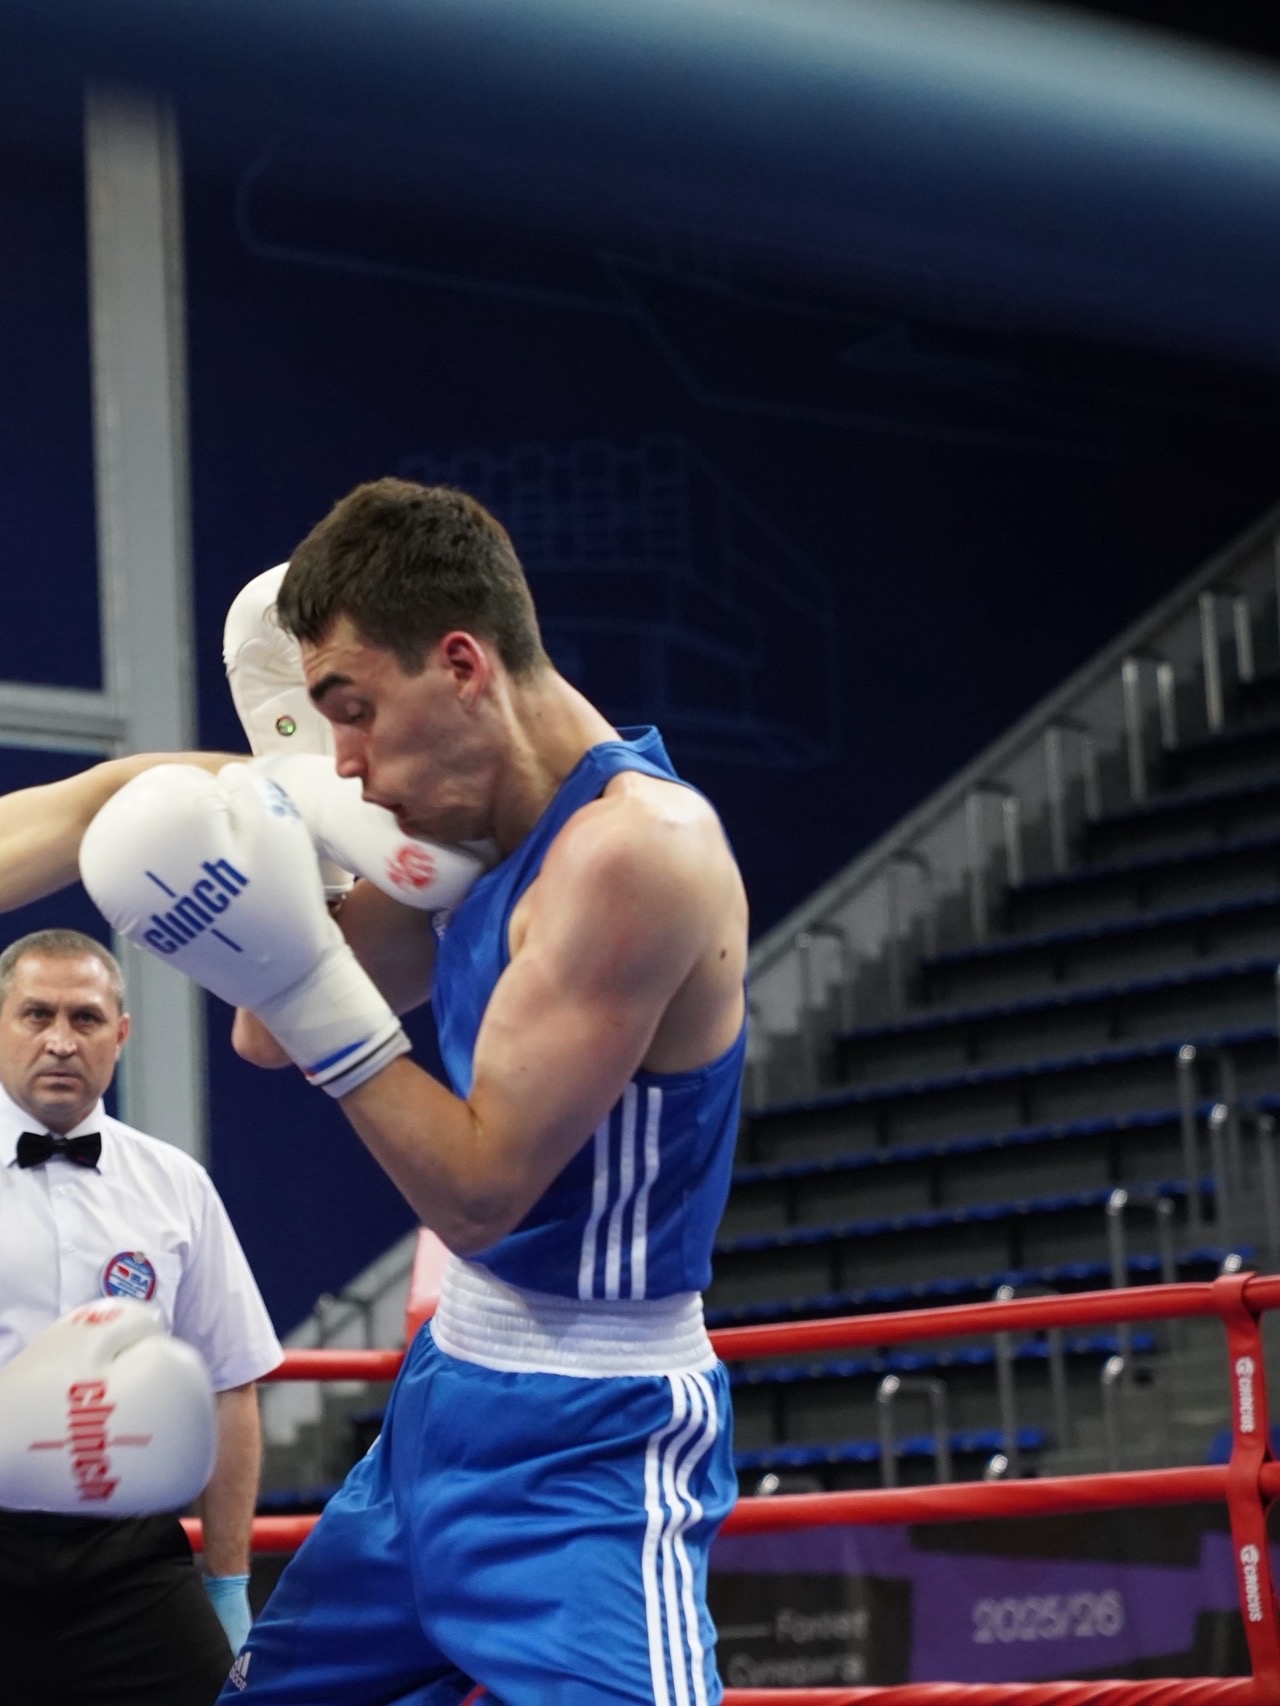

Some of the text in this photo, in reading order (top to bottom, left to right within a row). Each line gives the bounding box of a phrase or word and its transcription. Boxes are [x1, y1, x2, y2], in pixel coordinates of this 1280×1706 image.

[143, 858, 250, 955] clinch
[68, 1379, 119, 1501] clinch
[1237, 1376, 1256, 1434] CROCUS
[1243, 1563, 1264, 1623] CROCUS
